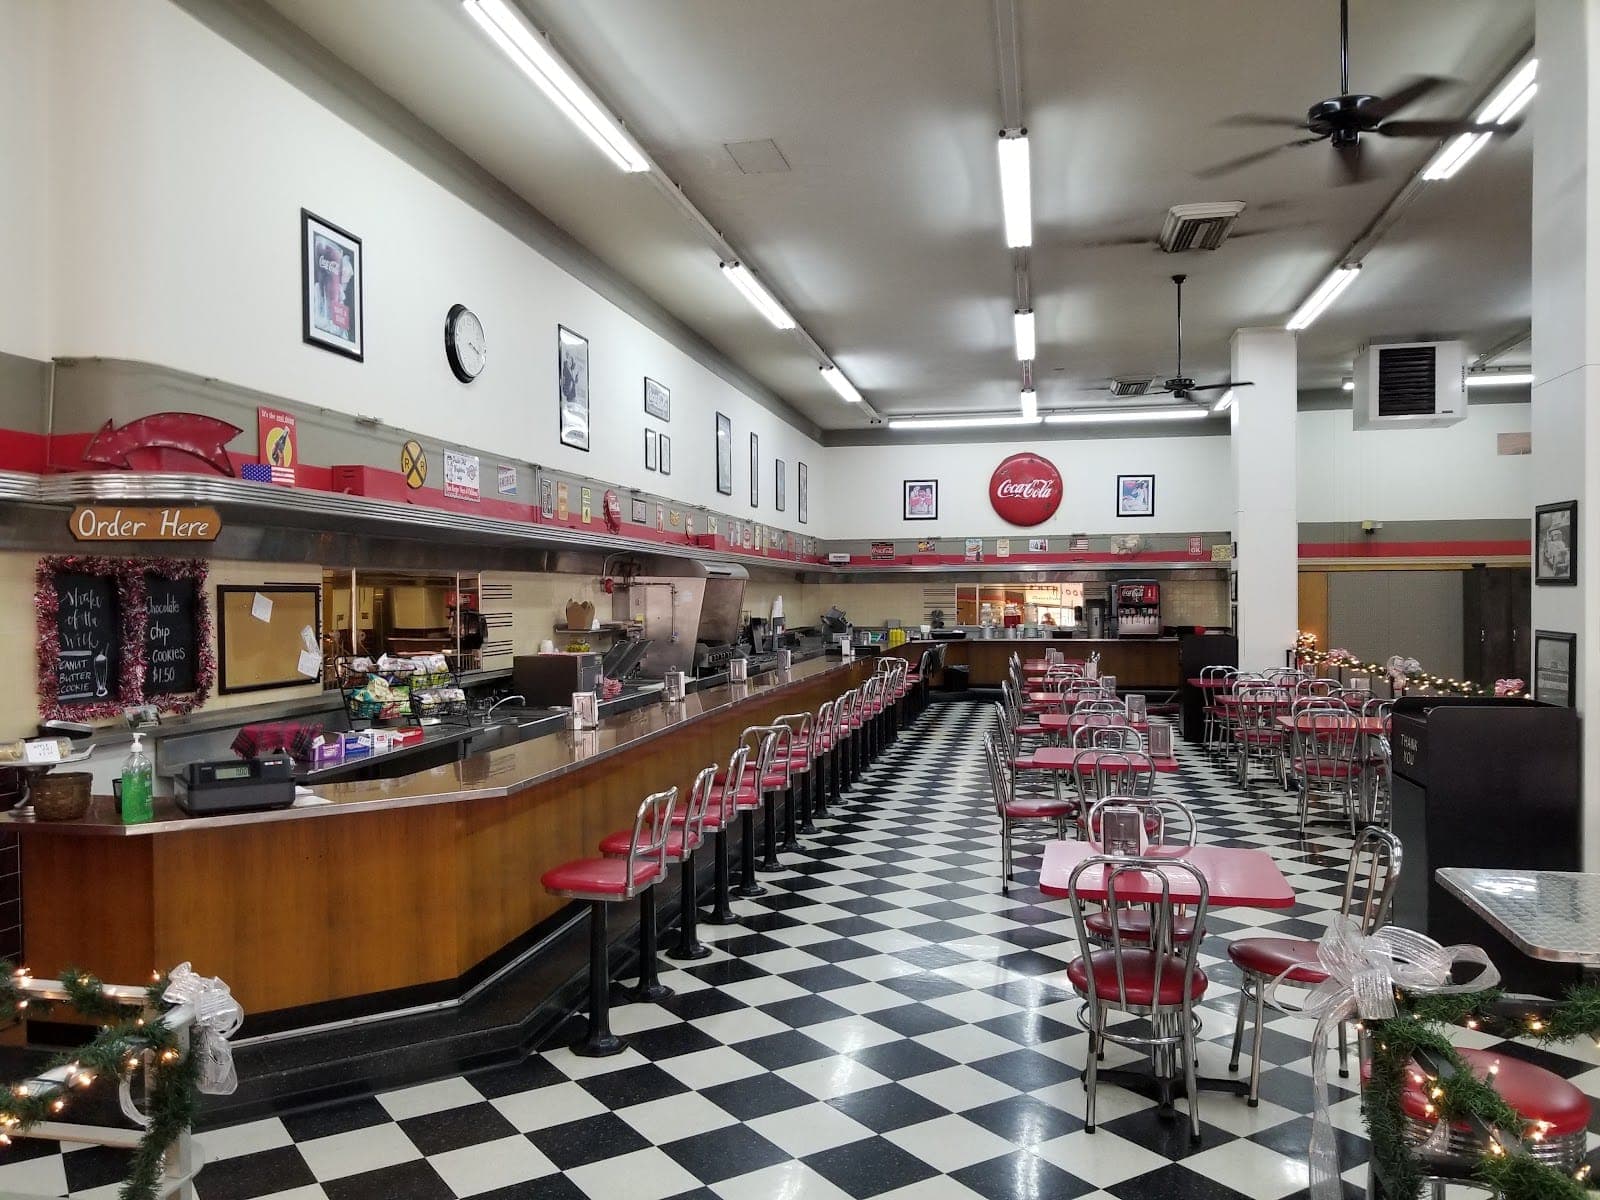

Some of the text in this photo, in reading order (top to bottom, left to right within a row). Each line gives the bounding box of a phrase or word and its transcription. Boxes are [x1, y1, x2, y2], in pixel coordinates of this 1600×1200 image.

[404, 458, 425, 471] R R
[997, 478, 1055, 500] Coca-Cola
[78, 509, 209, 537] Order Here
[153, 665, 175, 682] $1.50
[1401, 734, 1418, 751] THANK
